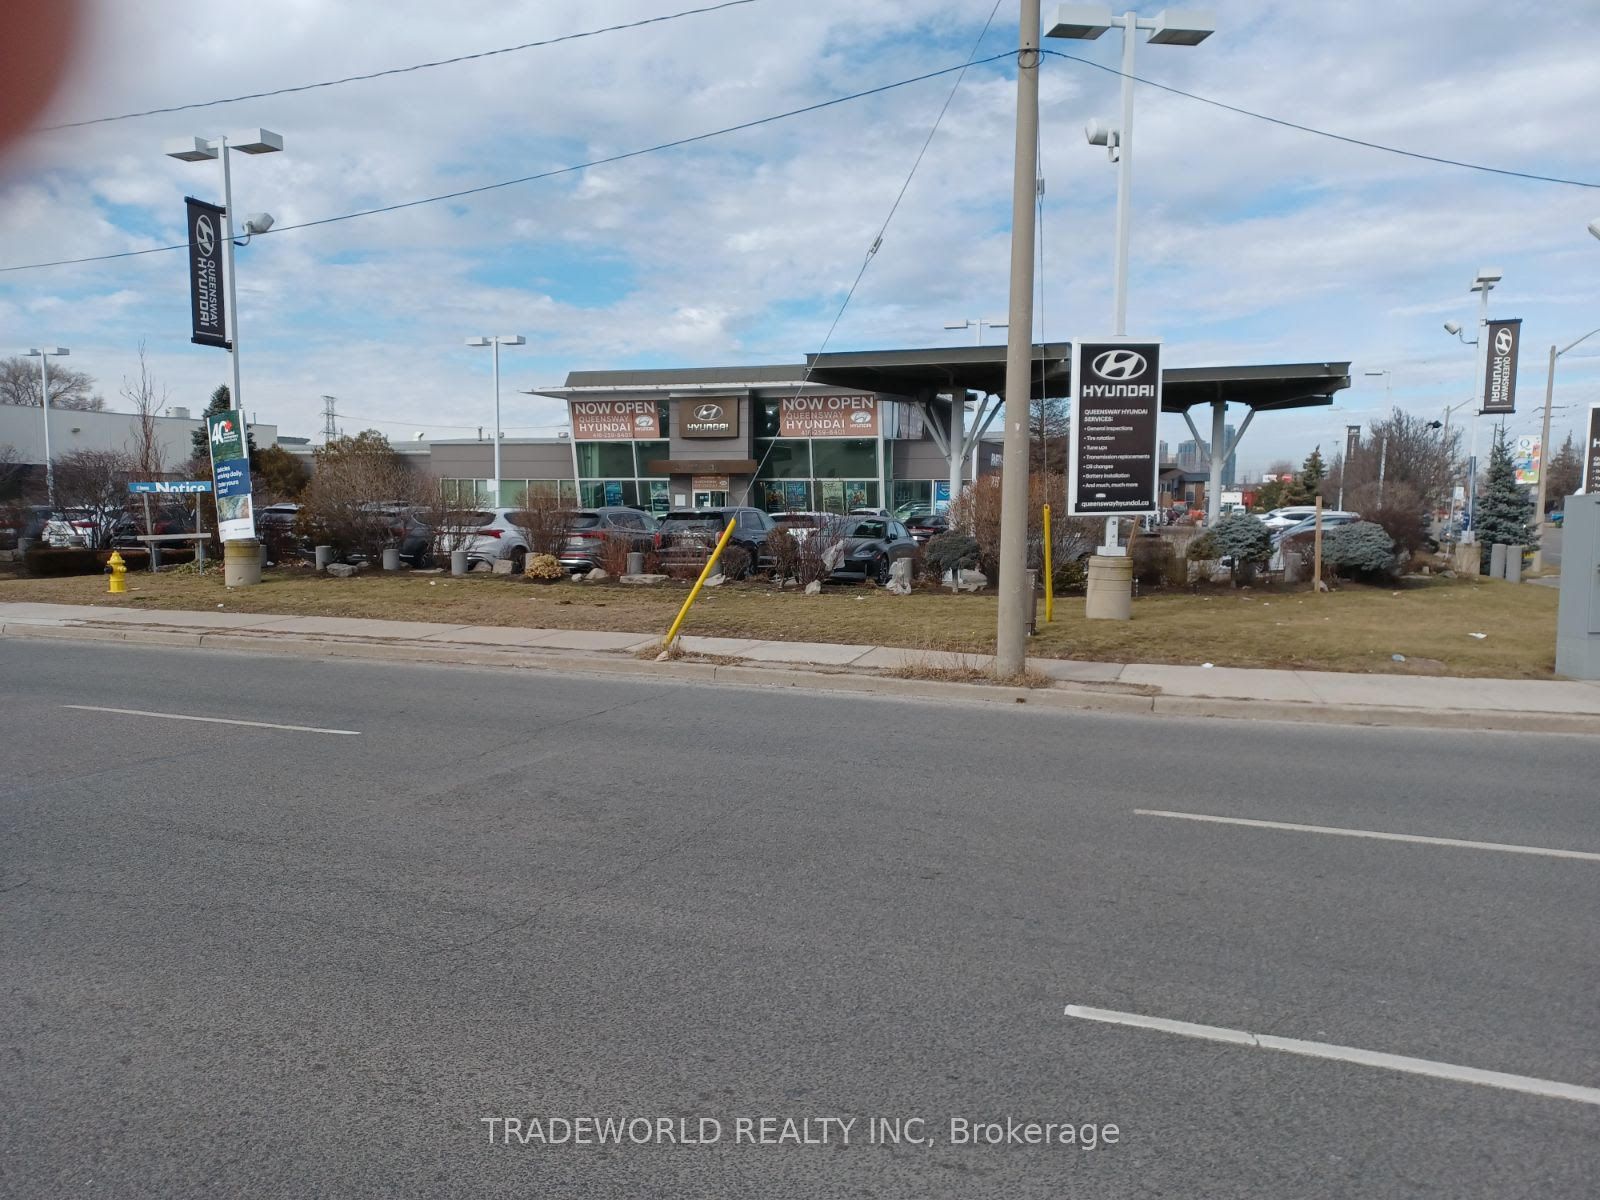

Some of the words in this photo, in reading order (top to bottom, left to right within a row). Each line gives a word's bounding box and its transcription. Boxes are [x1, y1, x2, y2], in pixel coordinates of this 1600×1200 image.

[197, 257, 210, 326] HYUNDAI
[206, 260, 218, 327] QUEENSWAY
[1491, 356, 1503, 402] HYUNDAI
[1500, 356, 1511, 401] QUEENSWAY
[1082, 384, 1155, 398] HYUNDAI
[575, 402, 612, 414] NOW
[614, 401, 656, 414] OPEN
[782, 397, 824, 411] NOW
[827, 396, 874, 410] OPEN
[578, 415, 629, 423] QUEENSWAY
[786, 411, 843, 420] QUEENSWAY
[579, 423, 631, 432] HYUNDAI
[687, 423, 729, 431] HYUNDAI
[786, 419, 845, 430] HYUNDAI
[1081, 499, 1150, 508] queenswayhyundai.ca
